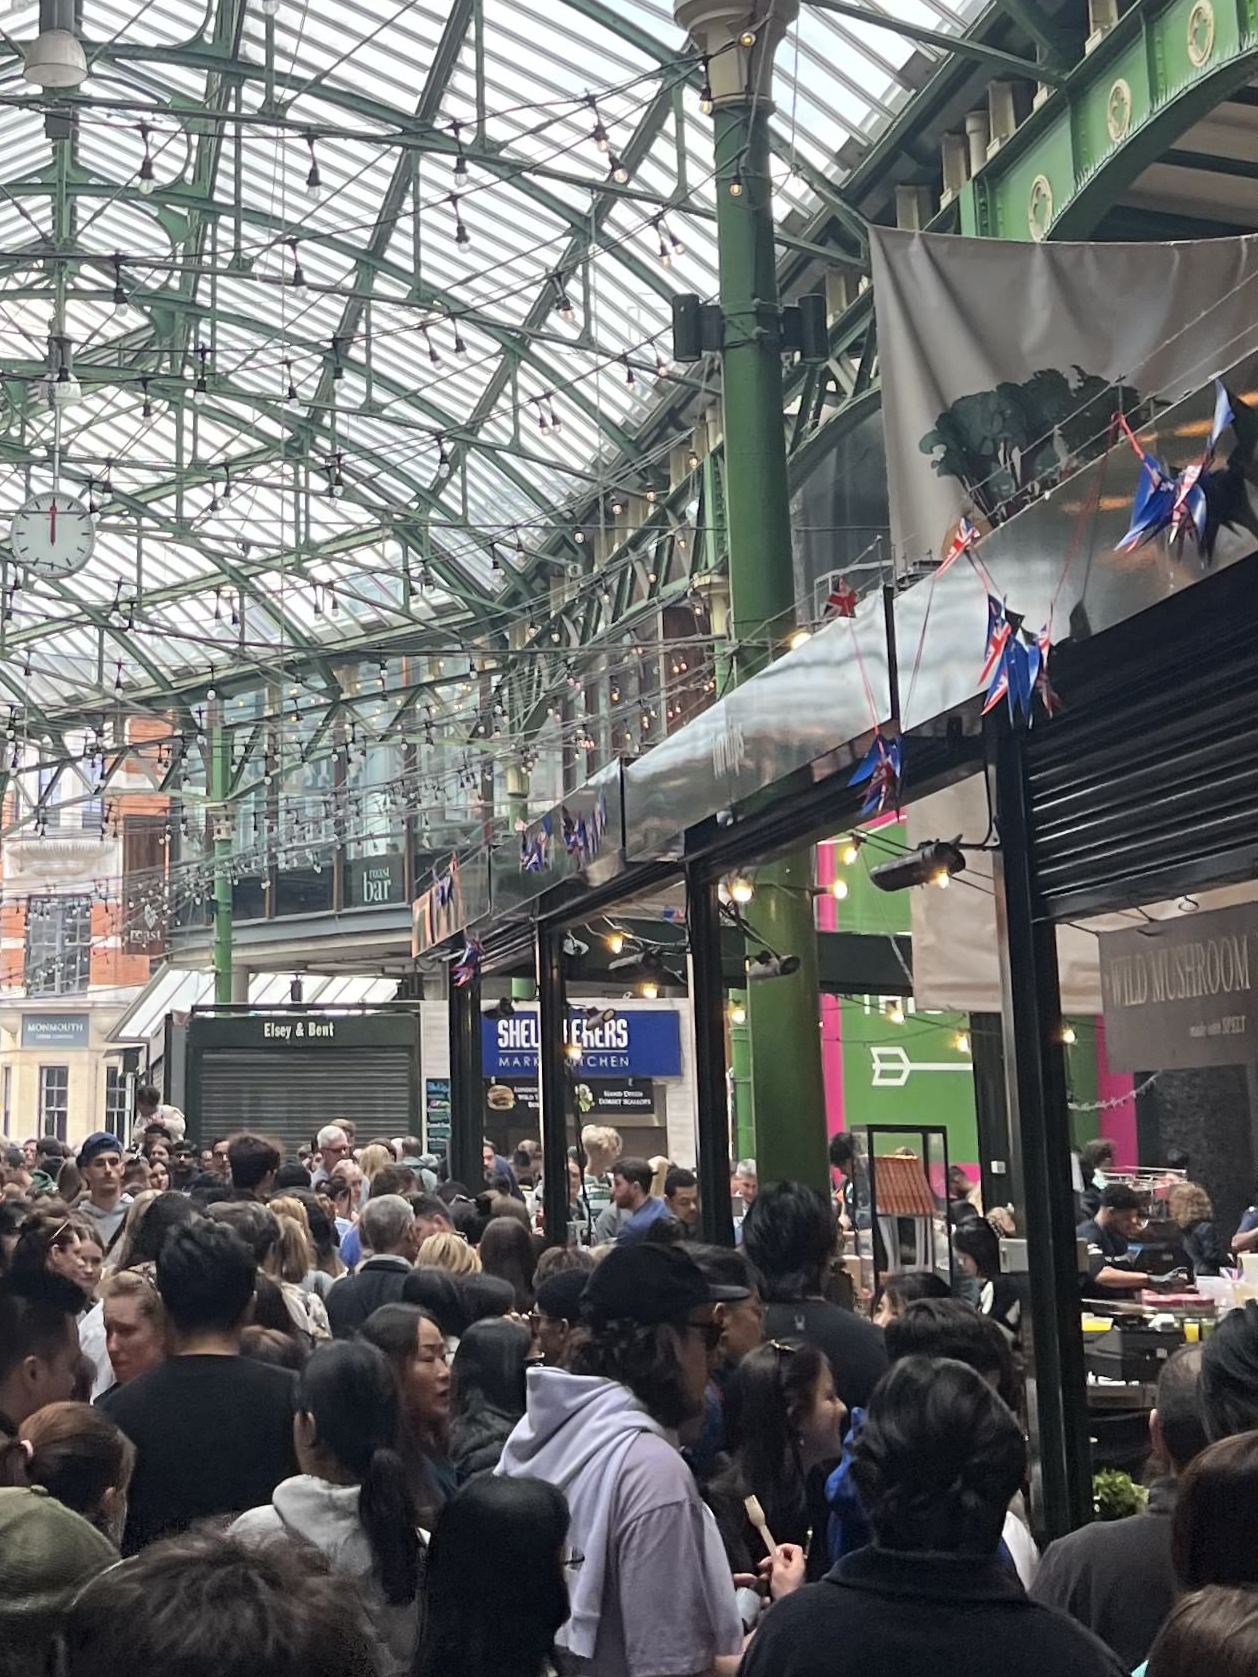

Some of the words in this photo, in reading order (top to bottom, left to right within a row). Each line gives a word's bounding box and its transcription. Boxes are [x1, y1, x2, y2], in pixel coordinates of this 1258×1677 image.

[363, 871, 391, 902] bar
[1110, 954, 1148, 1008] WILD
[1152, 936, 1251, 1002] MUSHROOM
[27, 1022, 83, 1032] MONMOUTH
[264, 1023, 291, 1040] Elsey
[296, 1022, 304, 1037] &
[308, 1022, 334, 1037] Bent
[497, 1019, 540, 1048] SHEL
